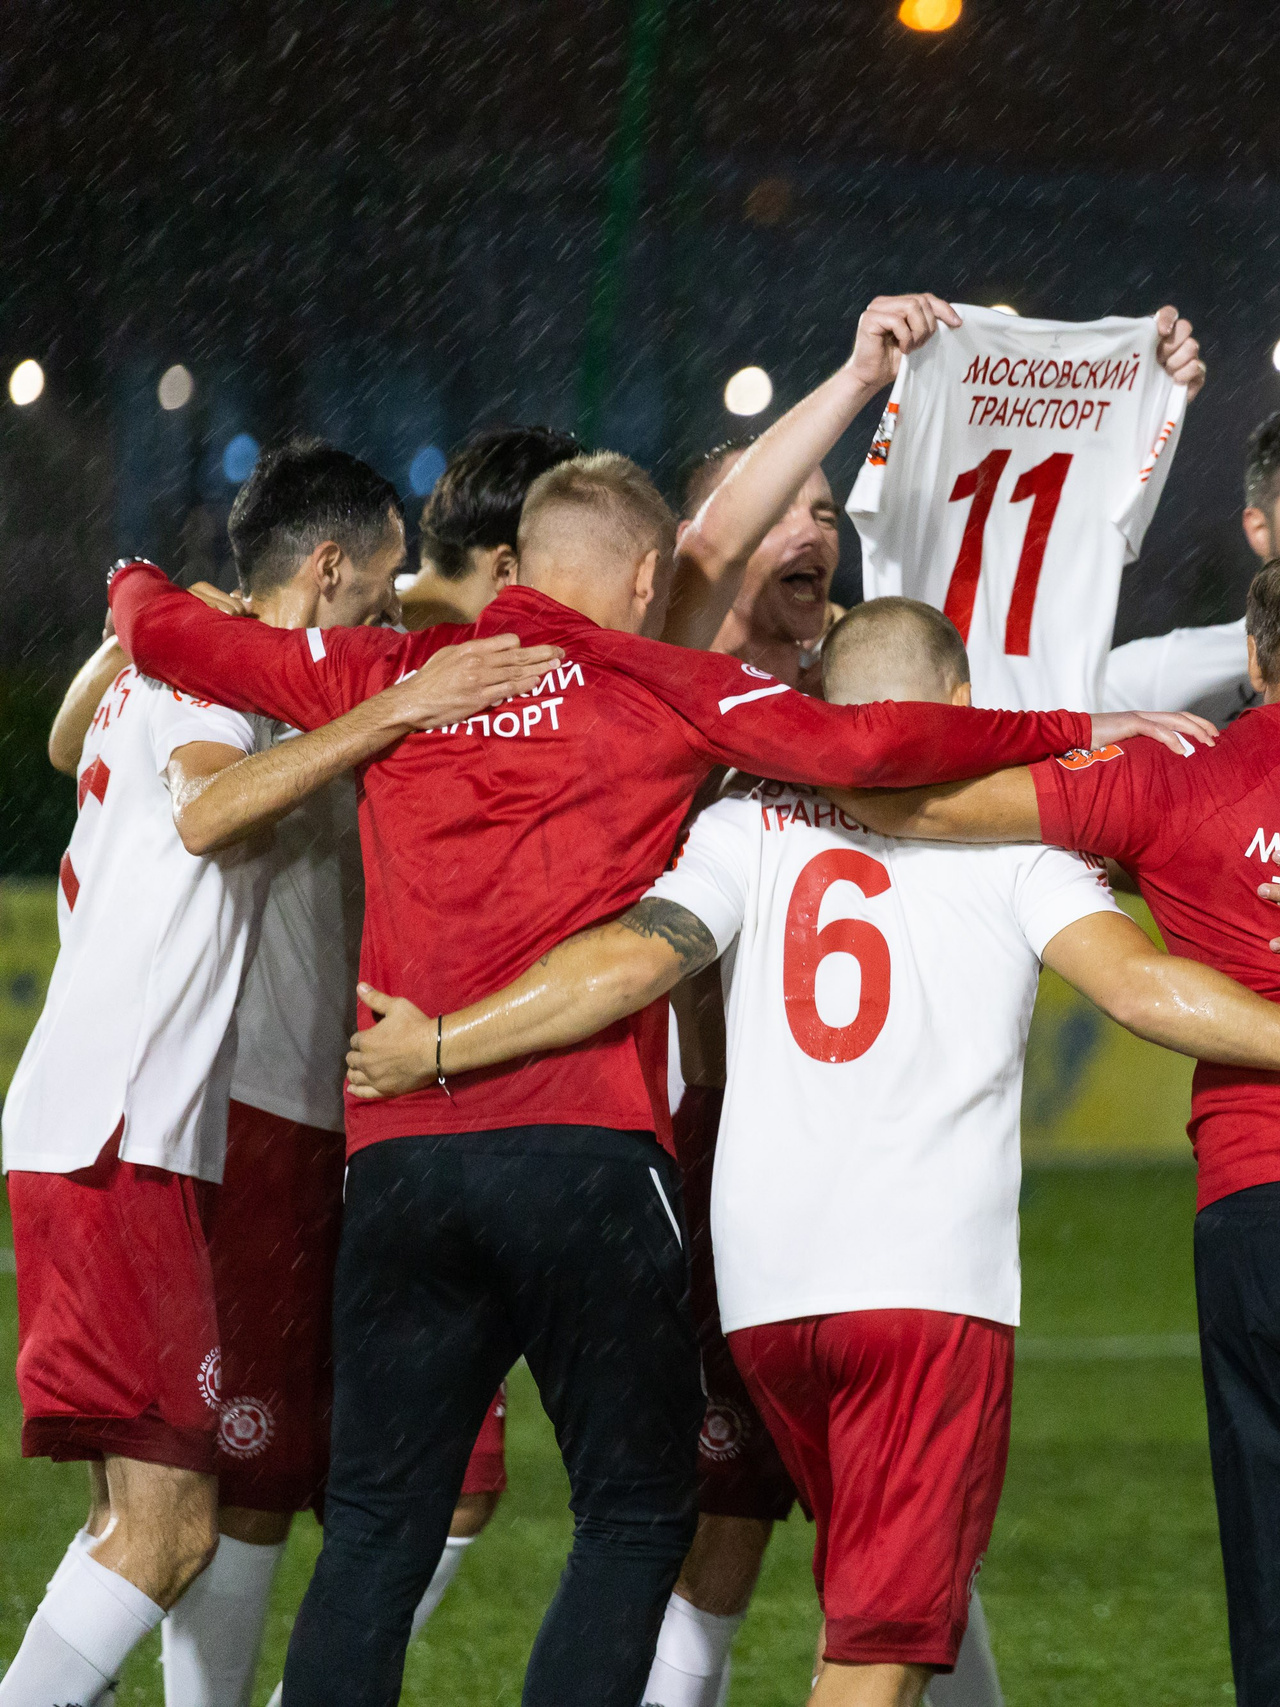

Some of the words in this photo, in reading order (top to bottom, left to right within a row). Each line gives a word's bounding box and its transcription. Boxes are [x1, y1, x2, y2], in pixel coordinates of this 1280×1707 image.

[962, 353, 1140, 392] МОСКОВСКИЙ
[967, 395, 1111, 432] ТРАНСПОРТ
[943, 449, 1074, 657] 11
[783, 848, 892, 1064] 6
